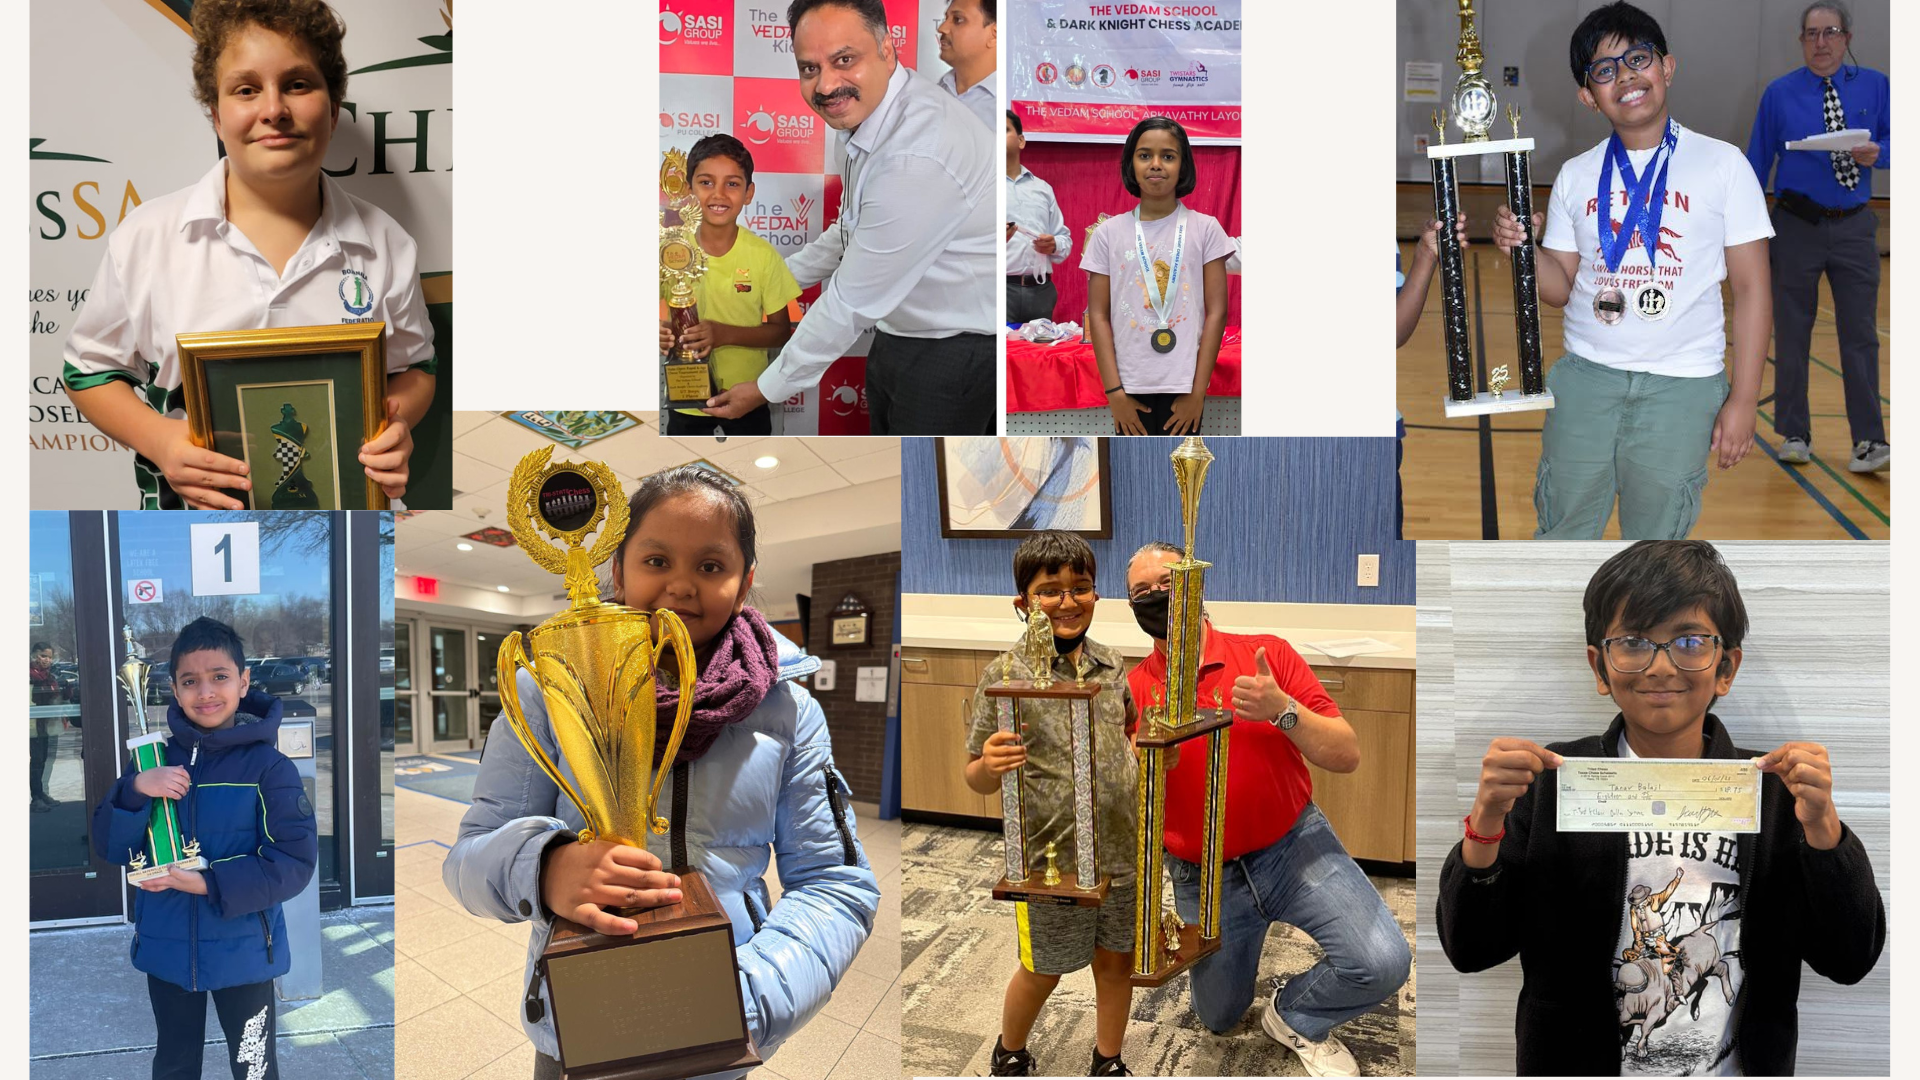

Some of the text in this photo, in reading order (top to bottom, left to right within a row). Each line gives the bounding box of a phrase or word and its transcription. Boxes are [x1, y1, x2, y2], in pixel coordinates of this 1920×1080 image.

[749, 9, 778, 22] The
[1089, 4, 1218, 16] THE VEDAM SCHOOL
[684, 14, 722, 29] SASI
[1046, 18, 1242, 31] & DARK KNIGHT CHESS ACADE
[684, 29, 722, 39] GROUP
[751, 24, 792, 39] VEDA
[1025, 106, 1047, 116] THE
[1050, 107, 1089, 118] VEDAM
[677, 112, 720, 129] SASI
[777, 115, 814, 129] SASI
[320, 100, 453, 178] CH
[776, 128, 814, 138] GROUP
[1586, 188, 1689, 216] RTRN
[744, 216, 809, 231] VEDAM
[752, 231, 808, 246] hool
[1658, 266, 1684, 276] THAT
[214, 533, 232, 582] 1
[1680, 832, 1711, 862] IS
